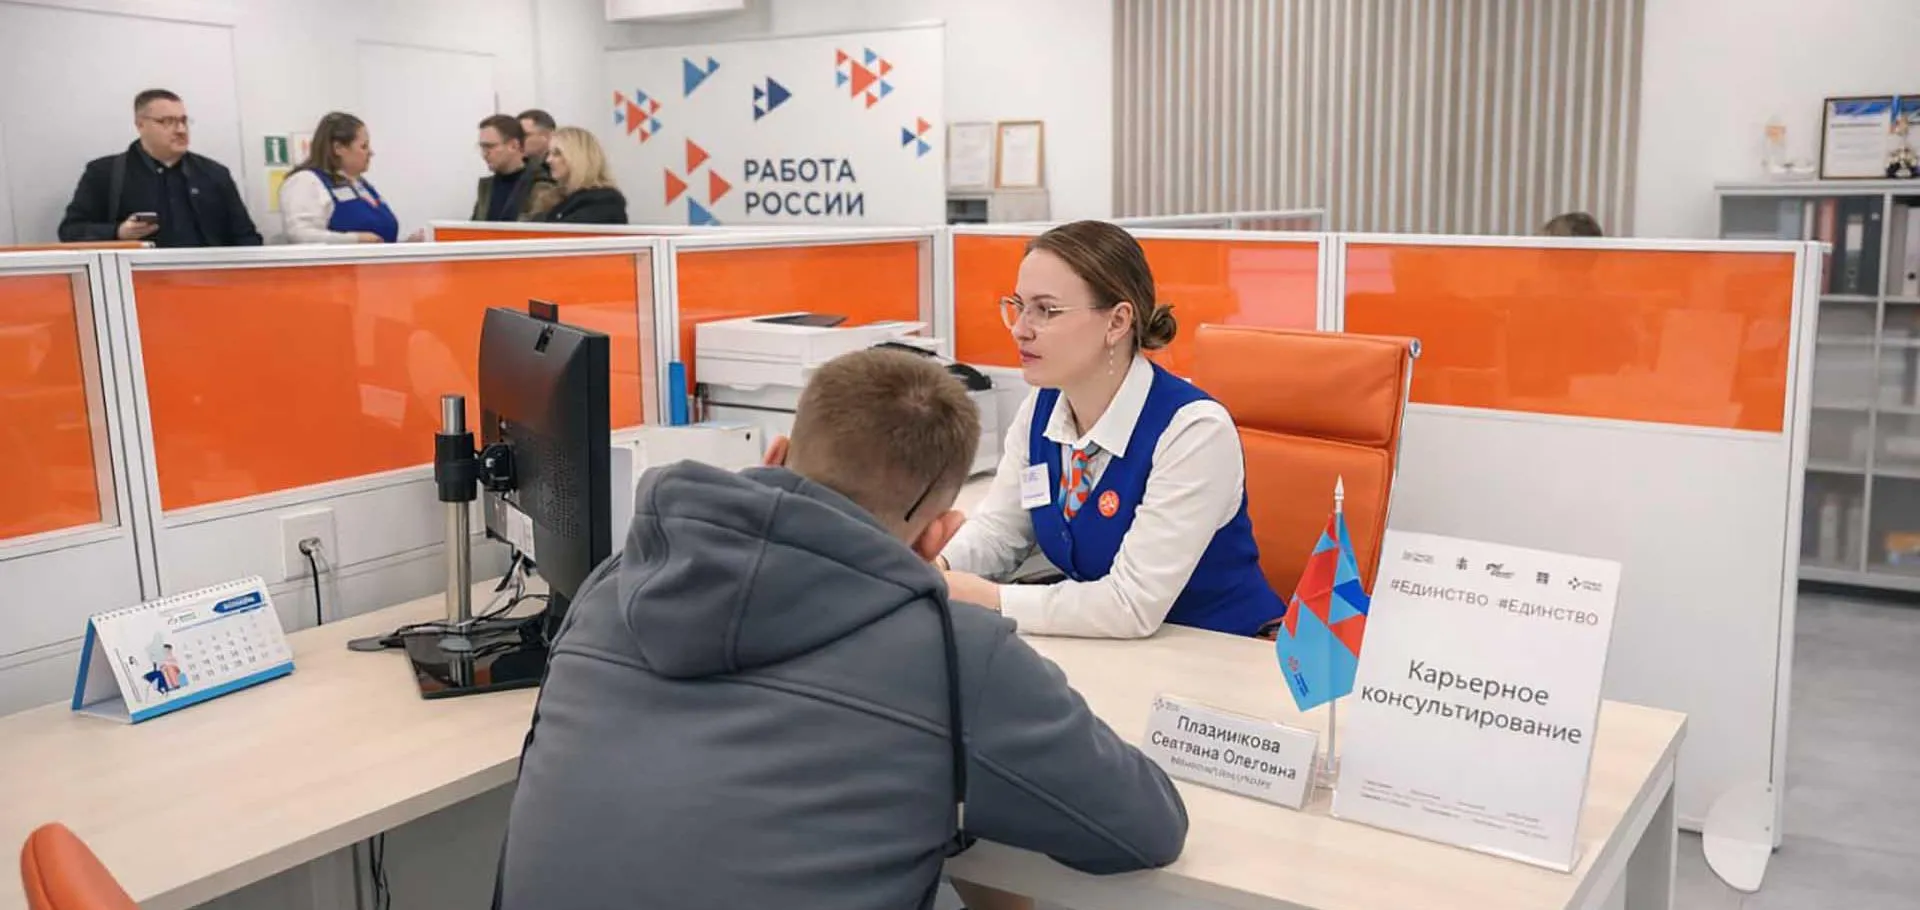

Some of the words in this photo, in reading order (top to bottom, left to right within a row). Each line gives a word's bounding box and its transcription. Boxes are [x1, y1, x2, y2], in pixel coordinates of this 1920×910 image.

[744, 158, 856, 182] РАБОТА
[745, 191, 864, 216] РОССИИ
[1390, 578, 1489, 607] #ЕДИНСТВО
[1498, 598, 1599, 627] #ЕДИНСТВО
[1408, 659, 1549, 706] Карьерное
[1361, 685, 1582, 744] консультирование
